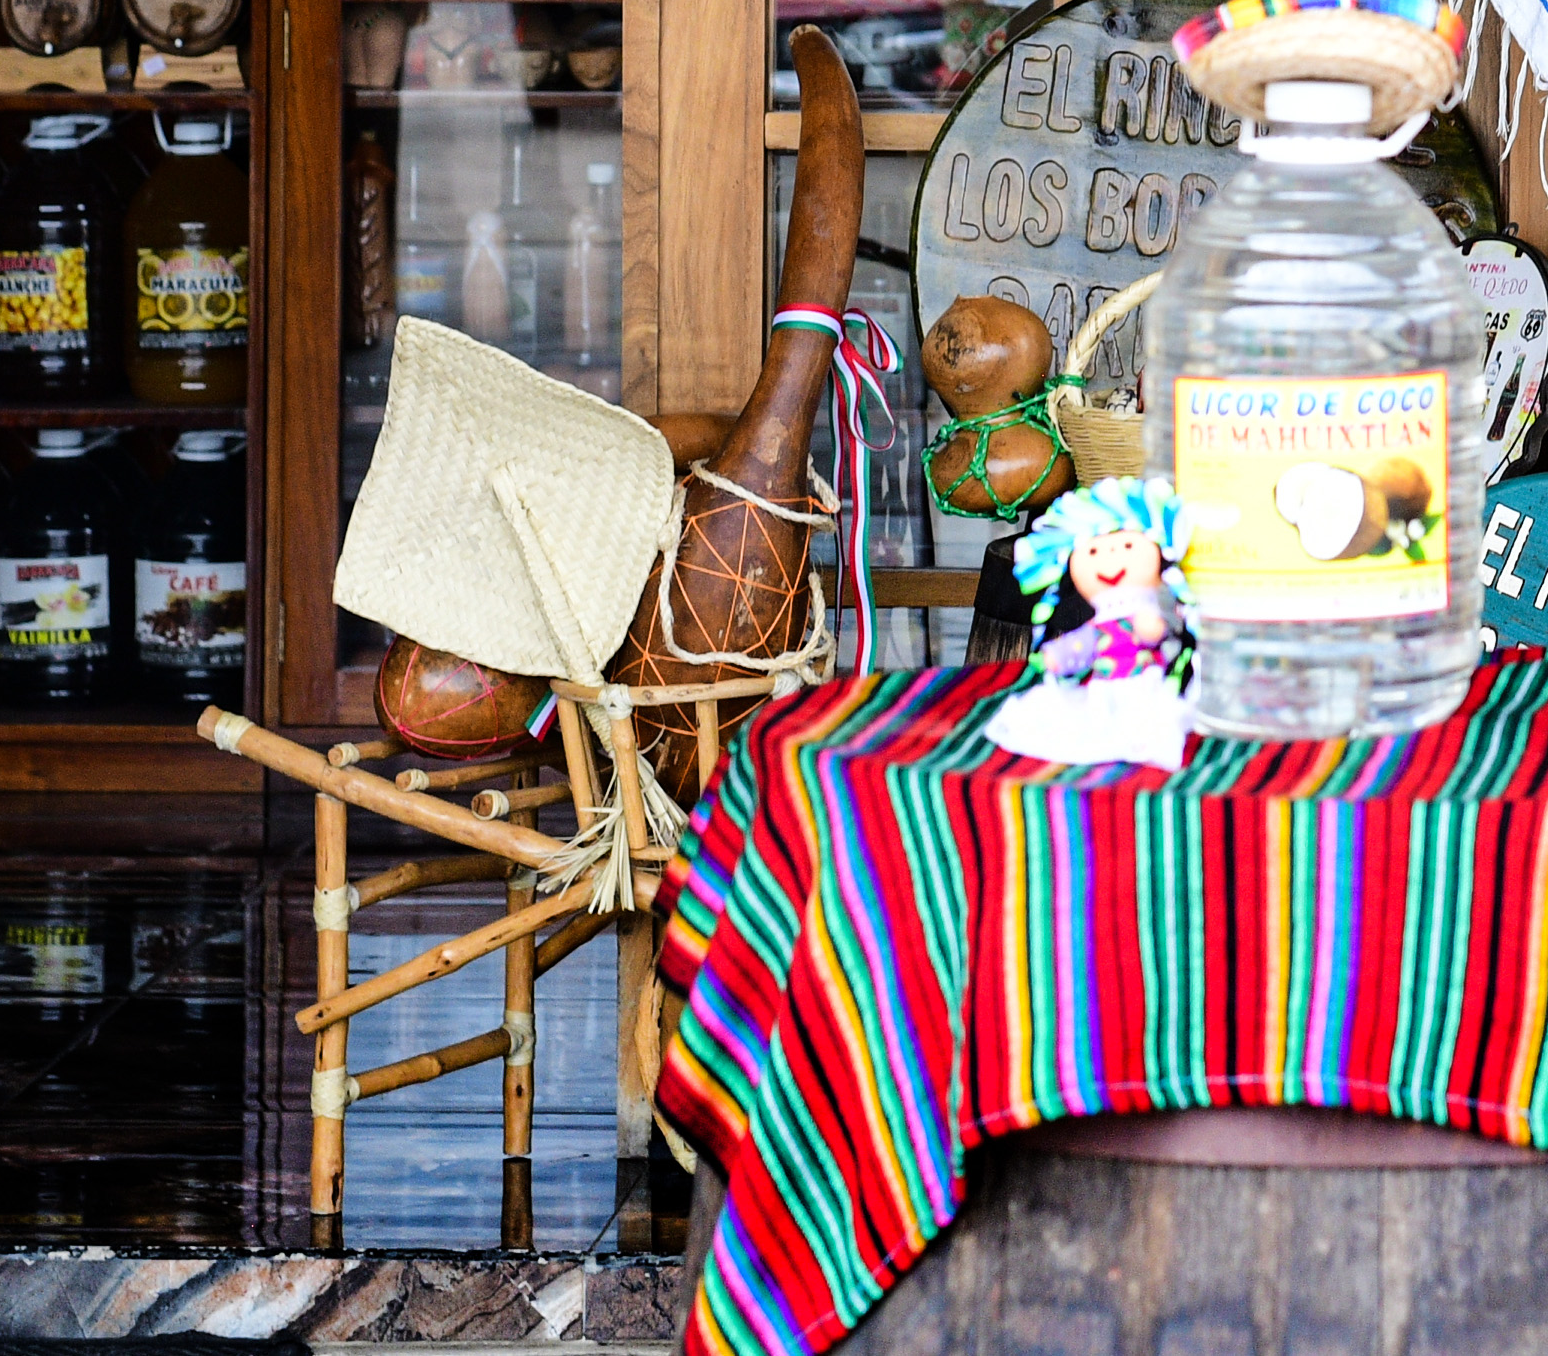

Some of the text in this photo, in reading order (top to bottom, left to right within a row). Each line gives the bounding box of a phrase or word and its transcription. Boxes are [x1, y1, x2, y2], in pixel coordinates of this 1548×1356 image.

[1000, 42, 1083, 133] EL
[943, 152, 1069, 249] LOS
[1524, 318, 1542, 337] 69
[1190, 385, 1435, 419] LICOR DE COCO
[1189, 419, 1433, 451] DE MAHUIXTLAN
[1480, 503, 1535, 599] EL
[170, 571, 219, 592] CAFÉ
[8, 628, 92, 645] VAINILLA
